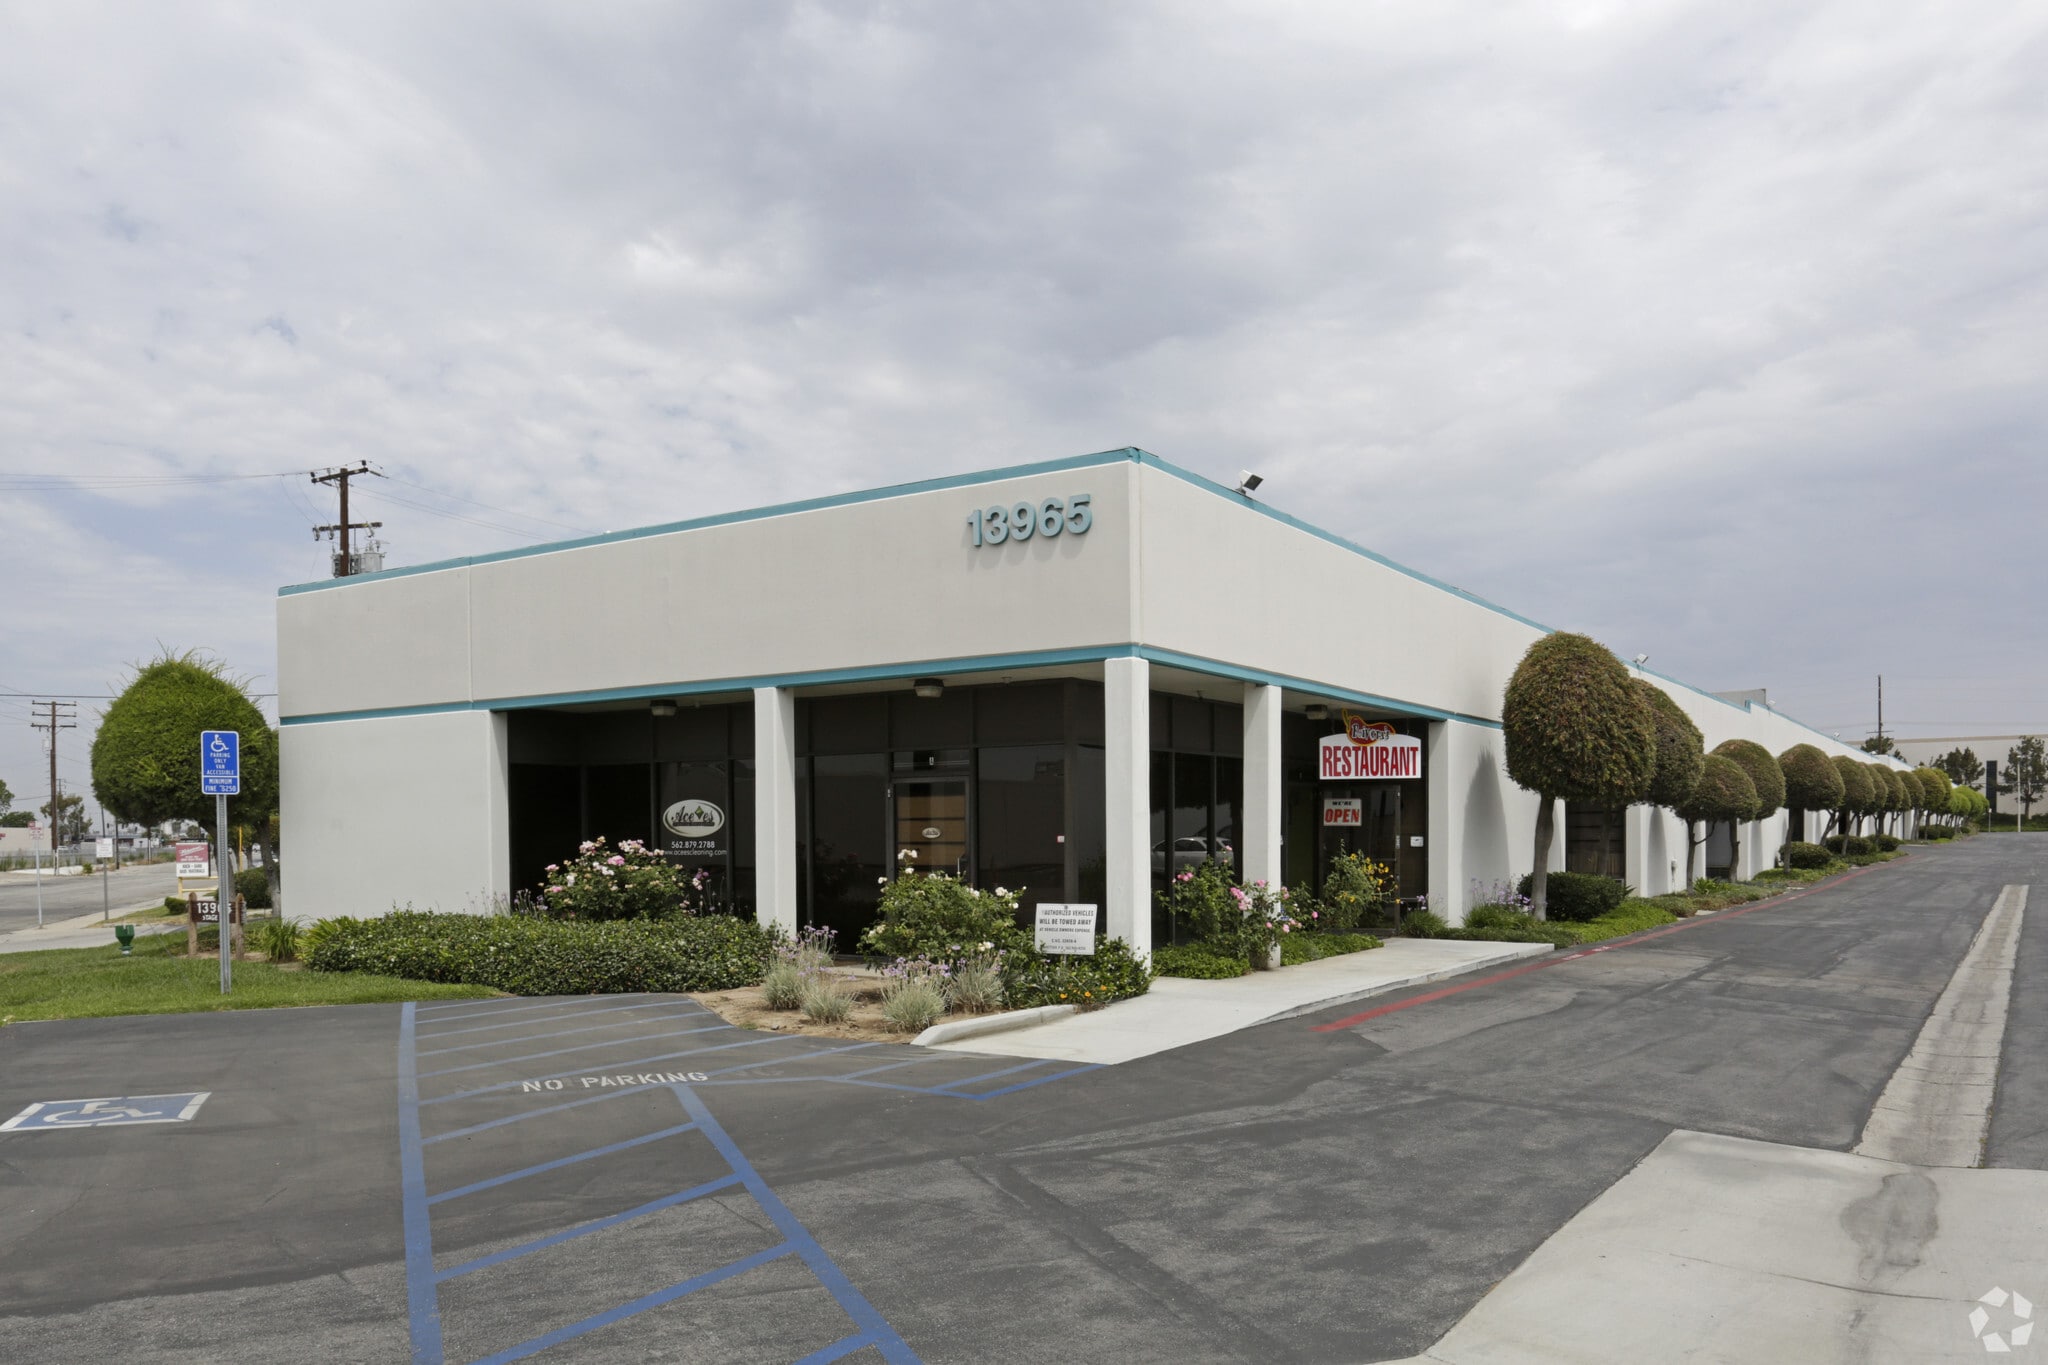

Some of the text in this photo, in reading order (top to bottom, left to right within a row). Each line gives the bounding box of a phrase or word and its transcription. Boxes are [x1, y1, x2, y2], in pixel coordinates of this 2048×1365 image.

[967, 493, 1092, 547] 13965
[1322, 746, 1418, 776] RESTAURANT
[1324, 808, 1360, 823] OPEN
[197, 902, 232, 914] 1395
[521, 1072, 709, 1093] NO PARKING
